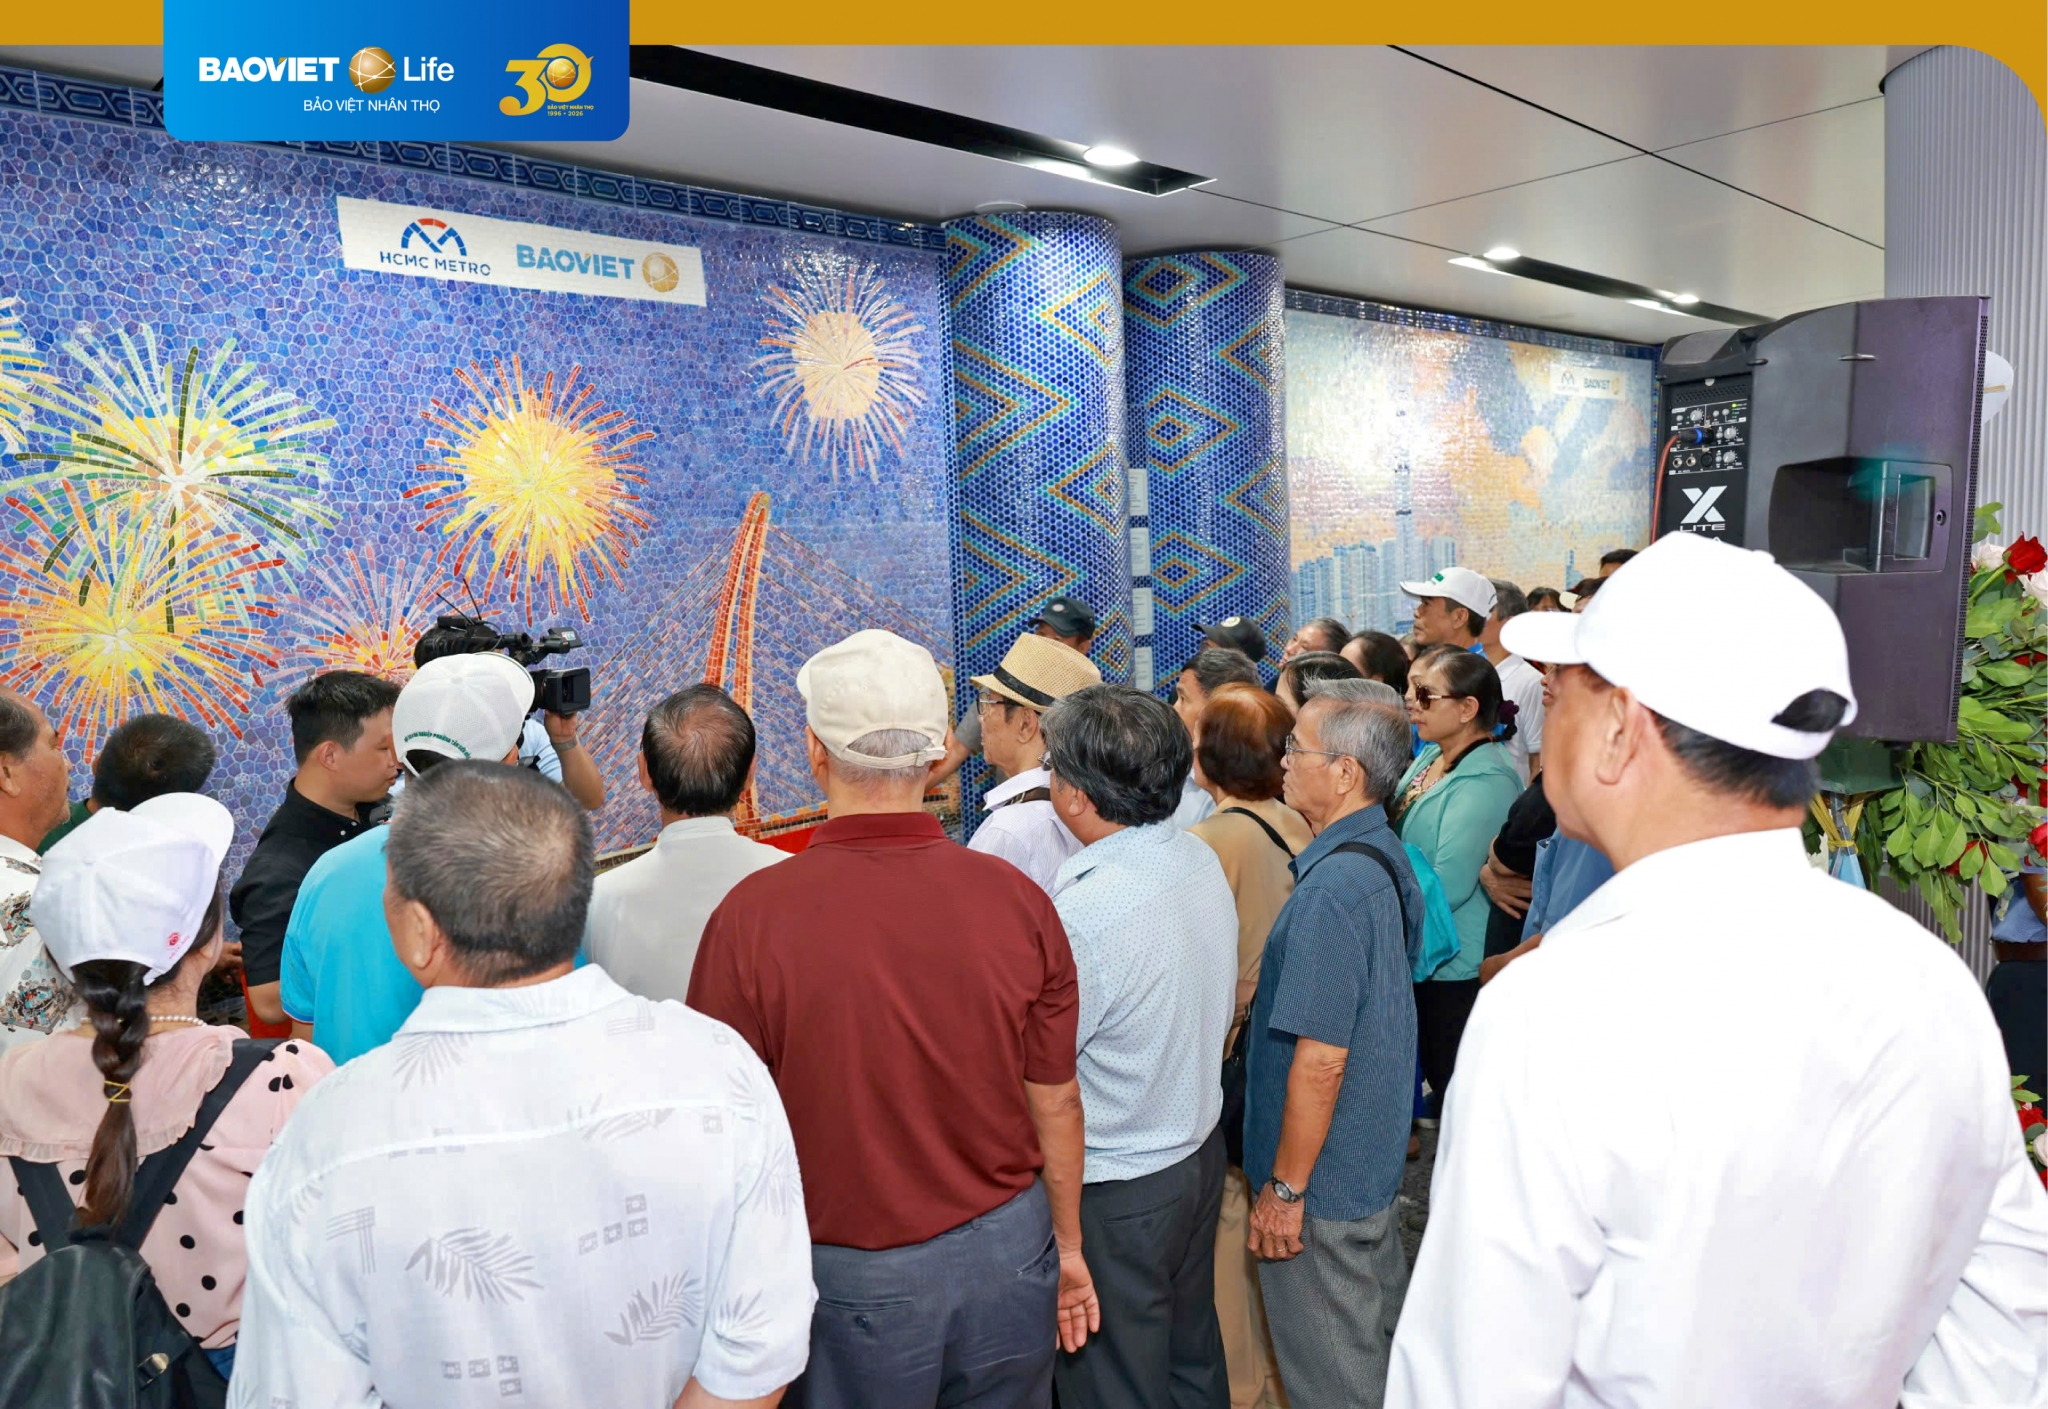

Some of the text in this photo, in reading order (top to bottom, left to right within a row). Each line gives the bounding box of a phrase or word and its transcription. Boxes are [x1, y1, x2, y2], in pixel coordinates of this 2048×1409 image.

[379, 251, 491, 277] HCMC METRO
[516, 244, 635, 280] BAOVIET
[1679, 523, 1726, 533] LITE
